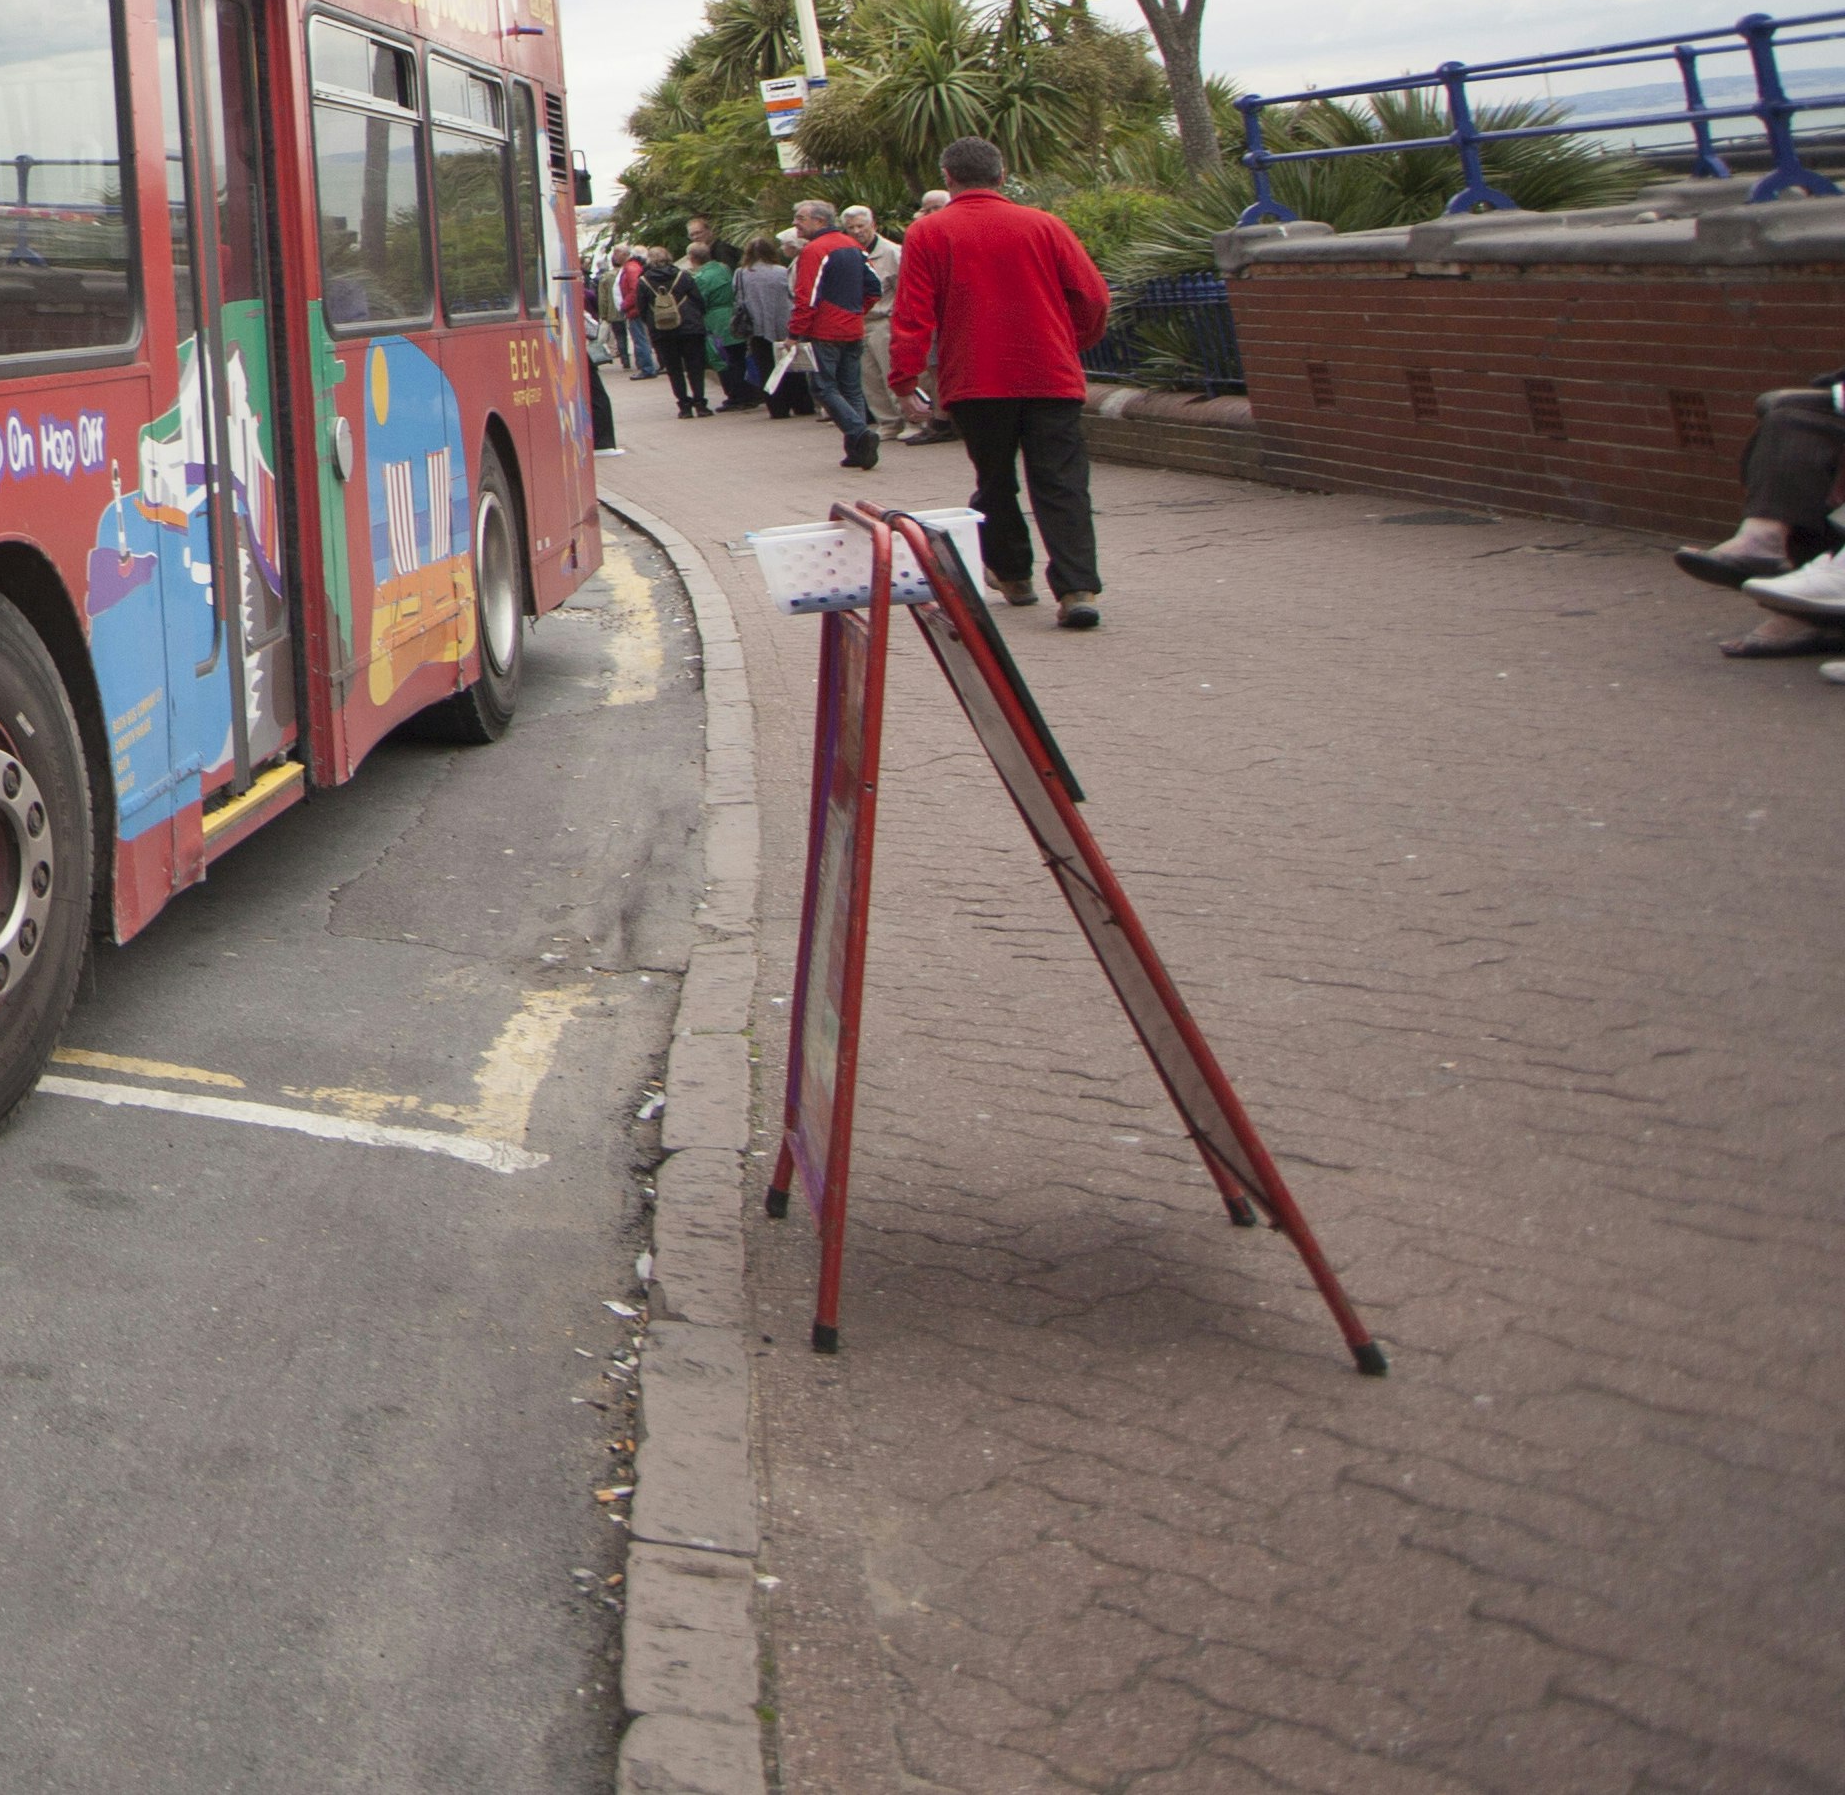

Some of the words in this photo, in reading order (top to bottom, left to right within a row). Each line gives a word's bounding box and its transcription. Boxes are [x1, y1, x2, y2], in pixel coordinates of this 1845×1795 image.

[6, 415, 35, 472] On
[41, 422, 76, 476] Hop
[78, 414, 104, 467] Off
